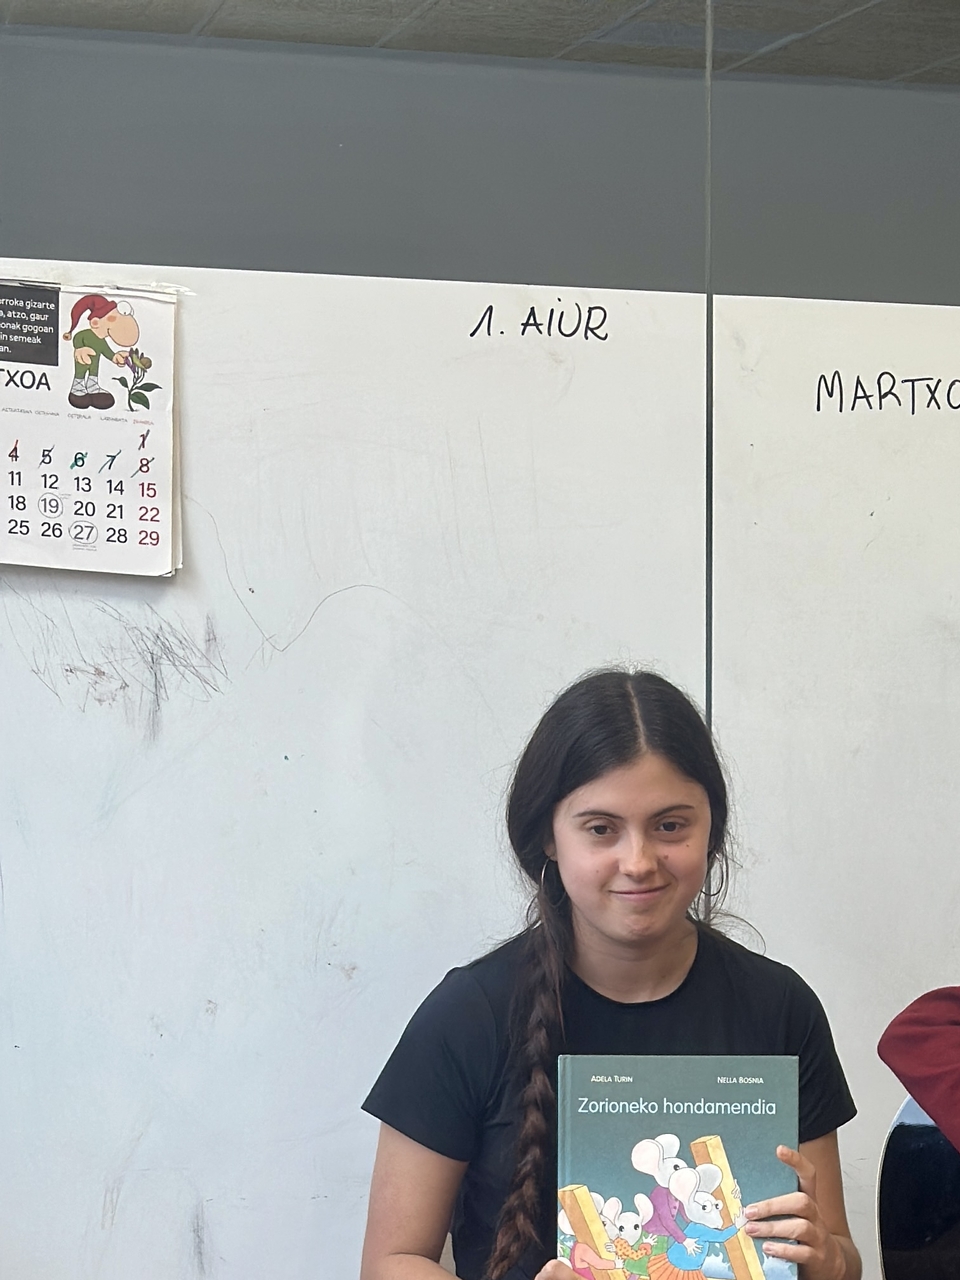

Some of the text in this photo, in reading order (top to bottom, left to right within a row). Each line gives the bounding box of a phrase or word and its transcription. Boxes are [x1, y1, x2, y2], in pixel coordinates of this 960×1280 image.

[25, 300, 55, 310] gizarte
[7, 310, 28, 320] atzo,
[30, 313, 49, 322] gaur
[470, 305, 504, 337] 1.
[0, 322, 54, 334] onak gogoan
[9, 335, 42, 344] semeak
[42, 449, 52, 464] 5
[74, 452, 85, 467] 6
[139, 458, 150, 473] 8
[8, 471, 157, 498] 11 12 13 14 15
[8, 495, 160, 522] 18 19 20 21 22
[8, 519, 160, 546] 25 26 27 28 29
[591, 1075, 633, 1083] ADELA TURIN
[717, 1076, 764, 1084] NELLA BOSNIA
[578, 1097, 776, 1115] Zorioneko hondamendia
